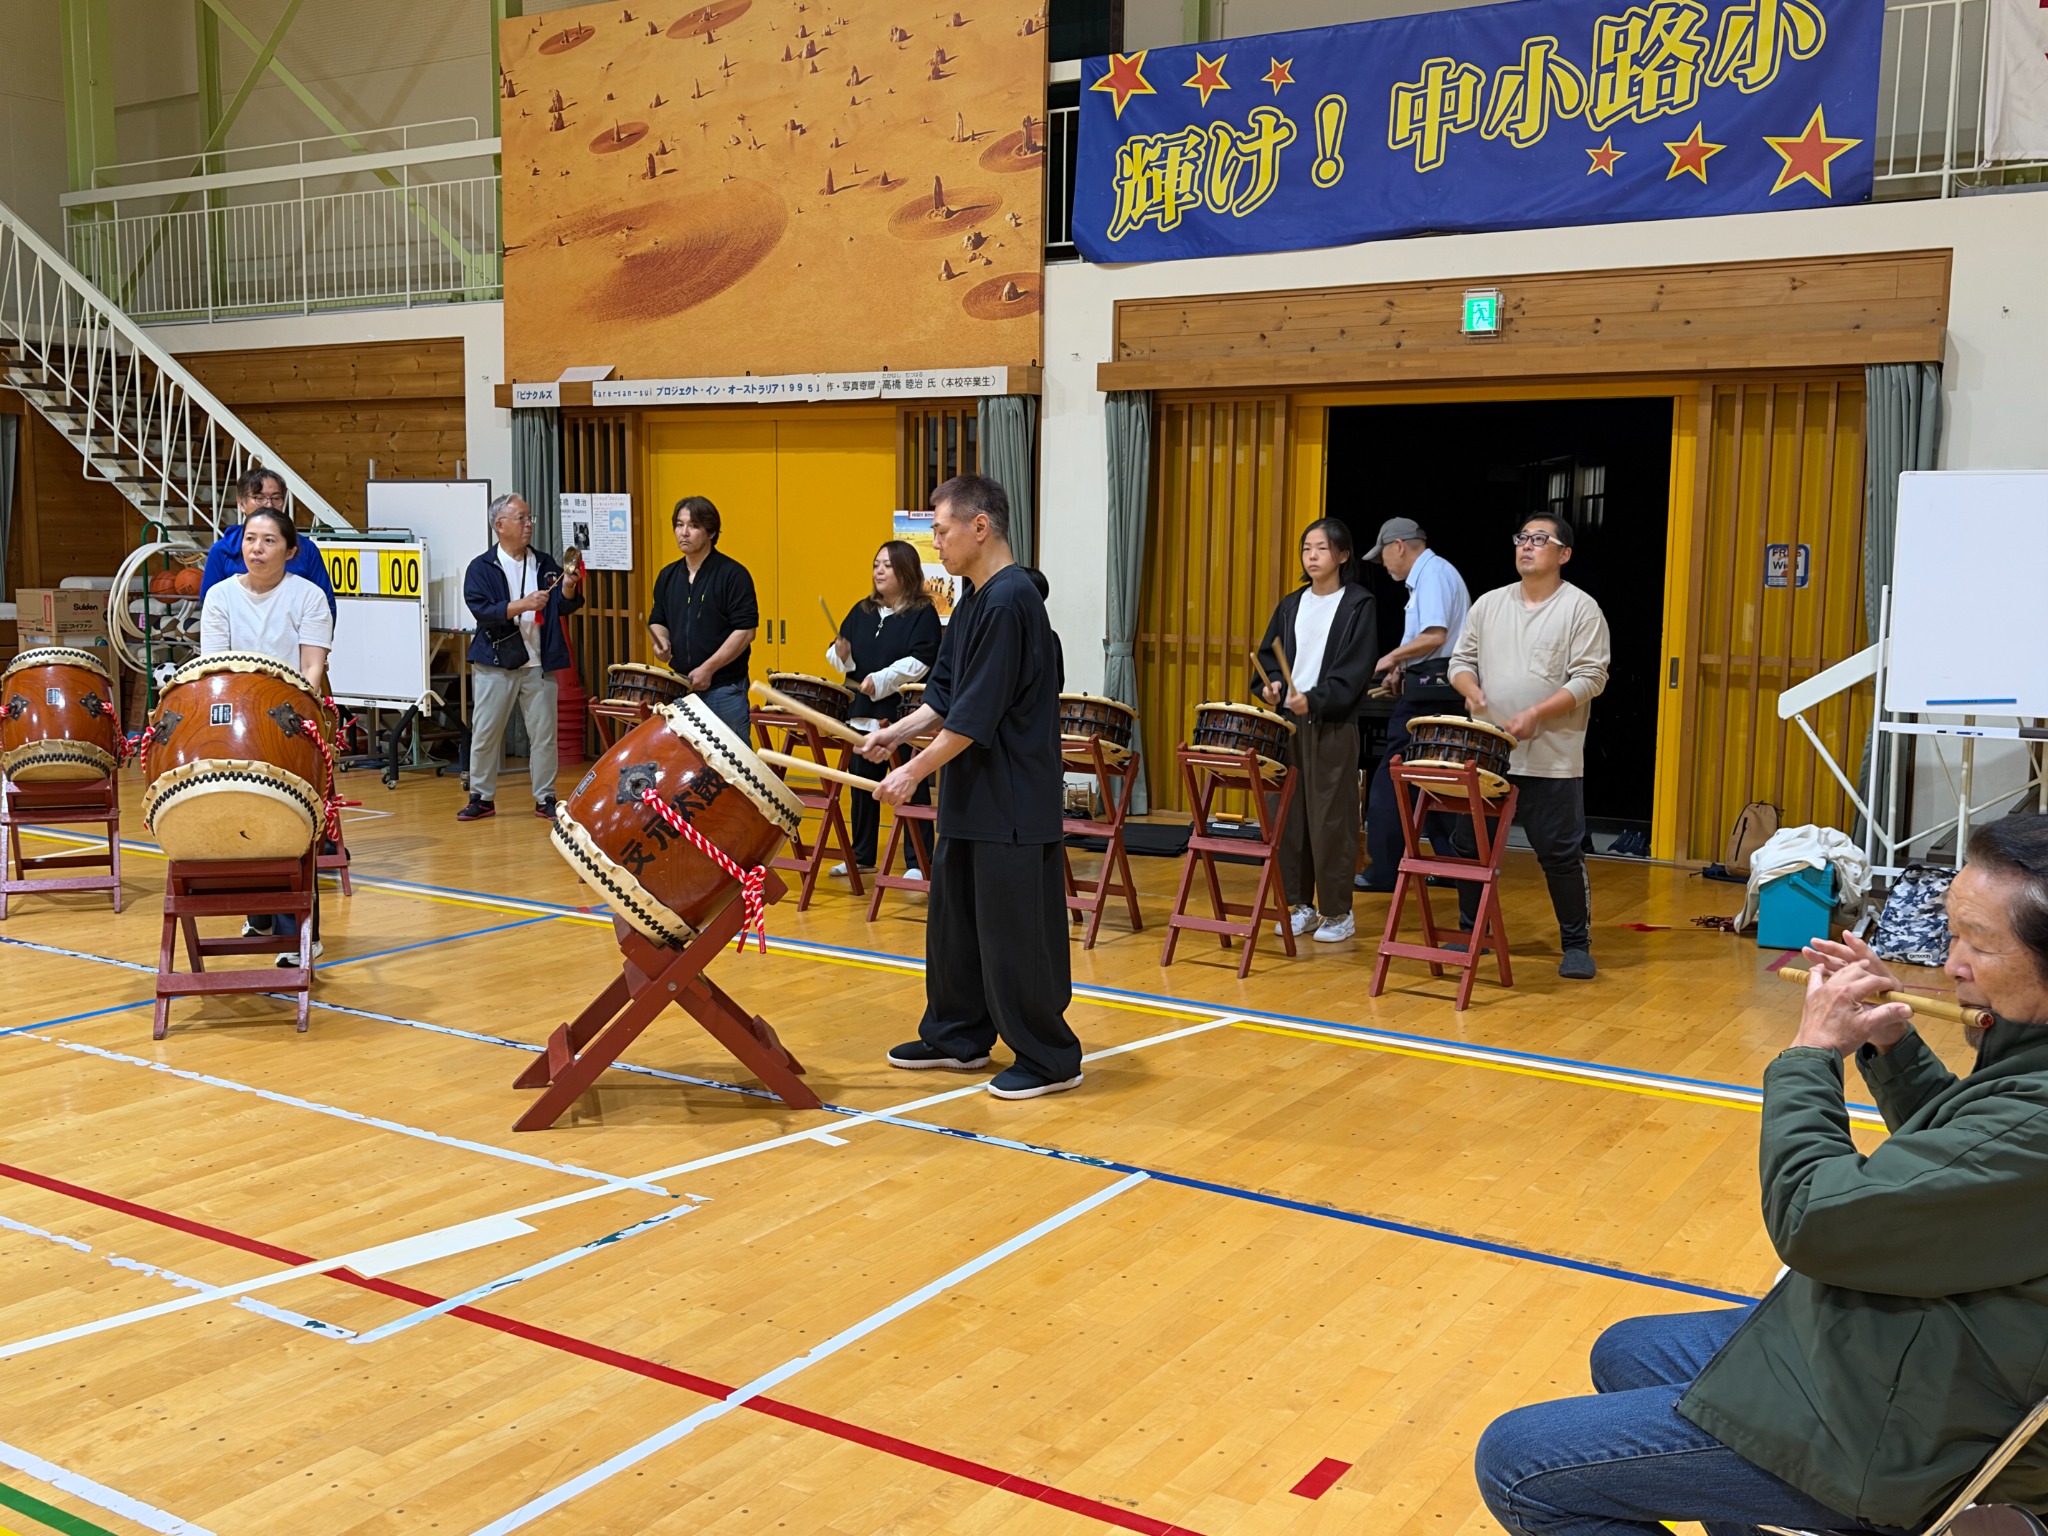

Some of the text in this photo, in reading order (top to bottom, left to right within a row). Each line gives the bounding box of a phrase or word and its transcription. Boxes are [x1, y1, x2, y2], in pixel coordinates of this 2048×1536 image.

[1388, 0, 1826, 172] 中小路小
[927, 378, 936, 388] 氏
[941, 375, 996, 388] (本校卒業生)
[331, 556, 419, 593] 00 00
